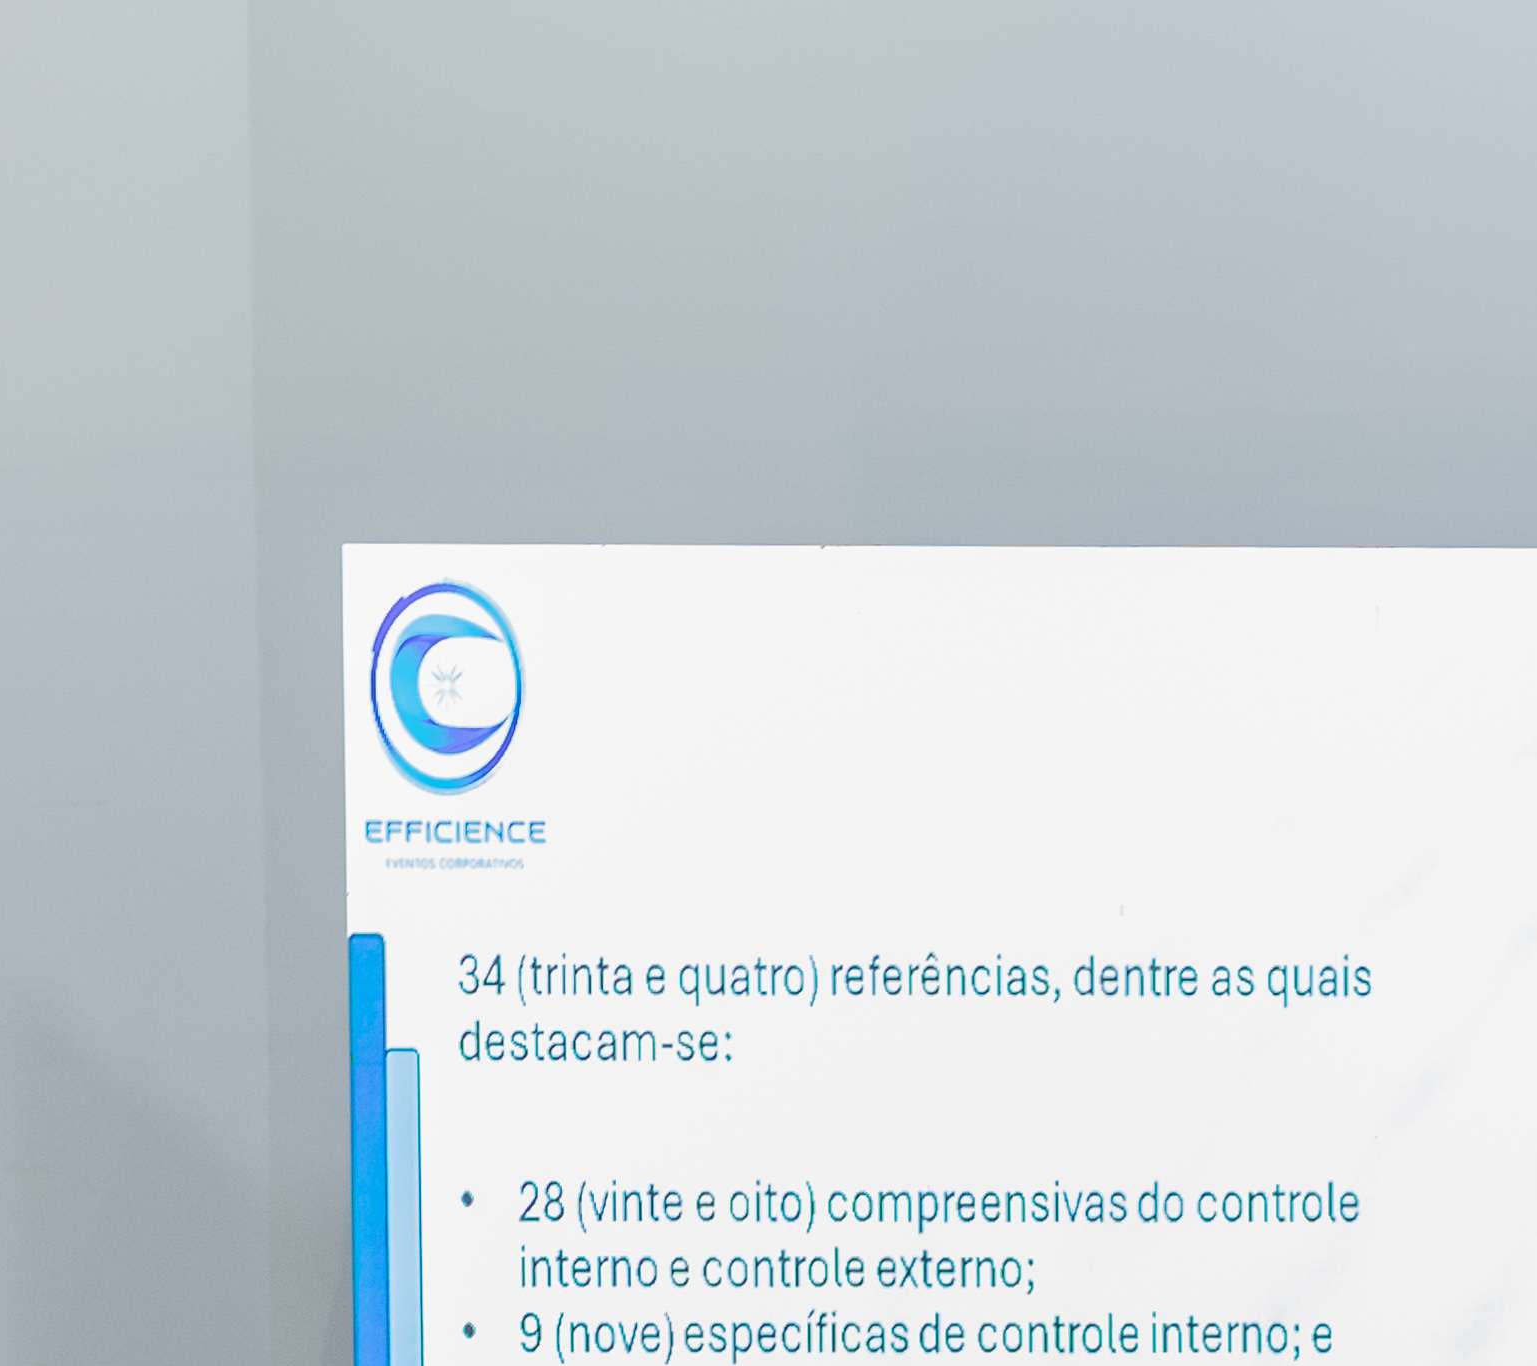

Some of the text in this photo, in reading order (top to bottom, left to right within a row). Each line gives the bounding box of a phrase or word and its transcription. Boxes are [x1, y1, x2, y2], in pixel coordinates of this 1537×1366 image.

[364, 819, 547, 844] EFFICIENCE
[457, 951, 1373, 1009] 34 (trinta e quatro) referências, dentre as quais
[458, 1019, 733, 1063] destacam-se:
[518, 1179, 1360, 1235] 28 (vinte e oito) compreensivas do controle
[520, 1244, 1035, 1295] interno e controle externo;
[519, 1308, 1333, 1366] 9 (nove) específicas de controle interno; e
